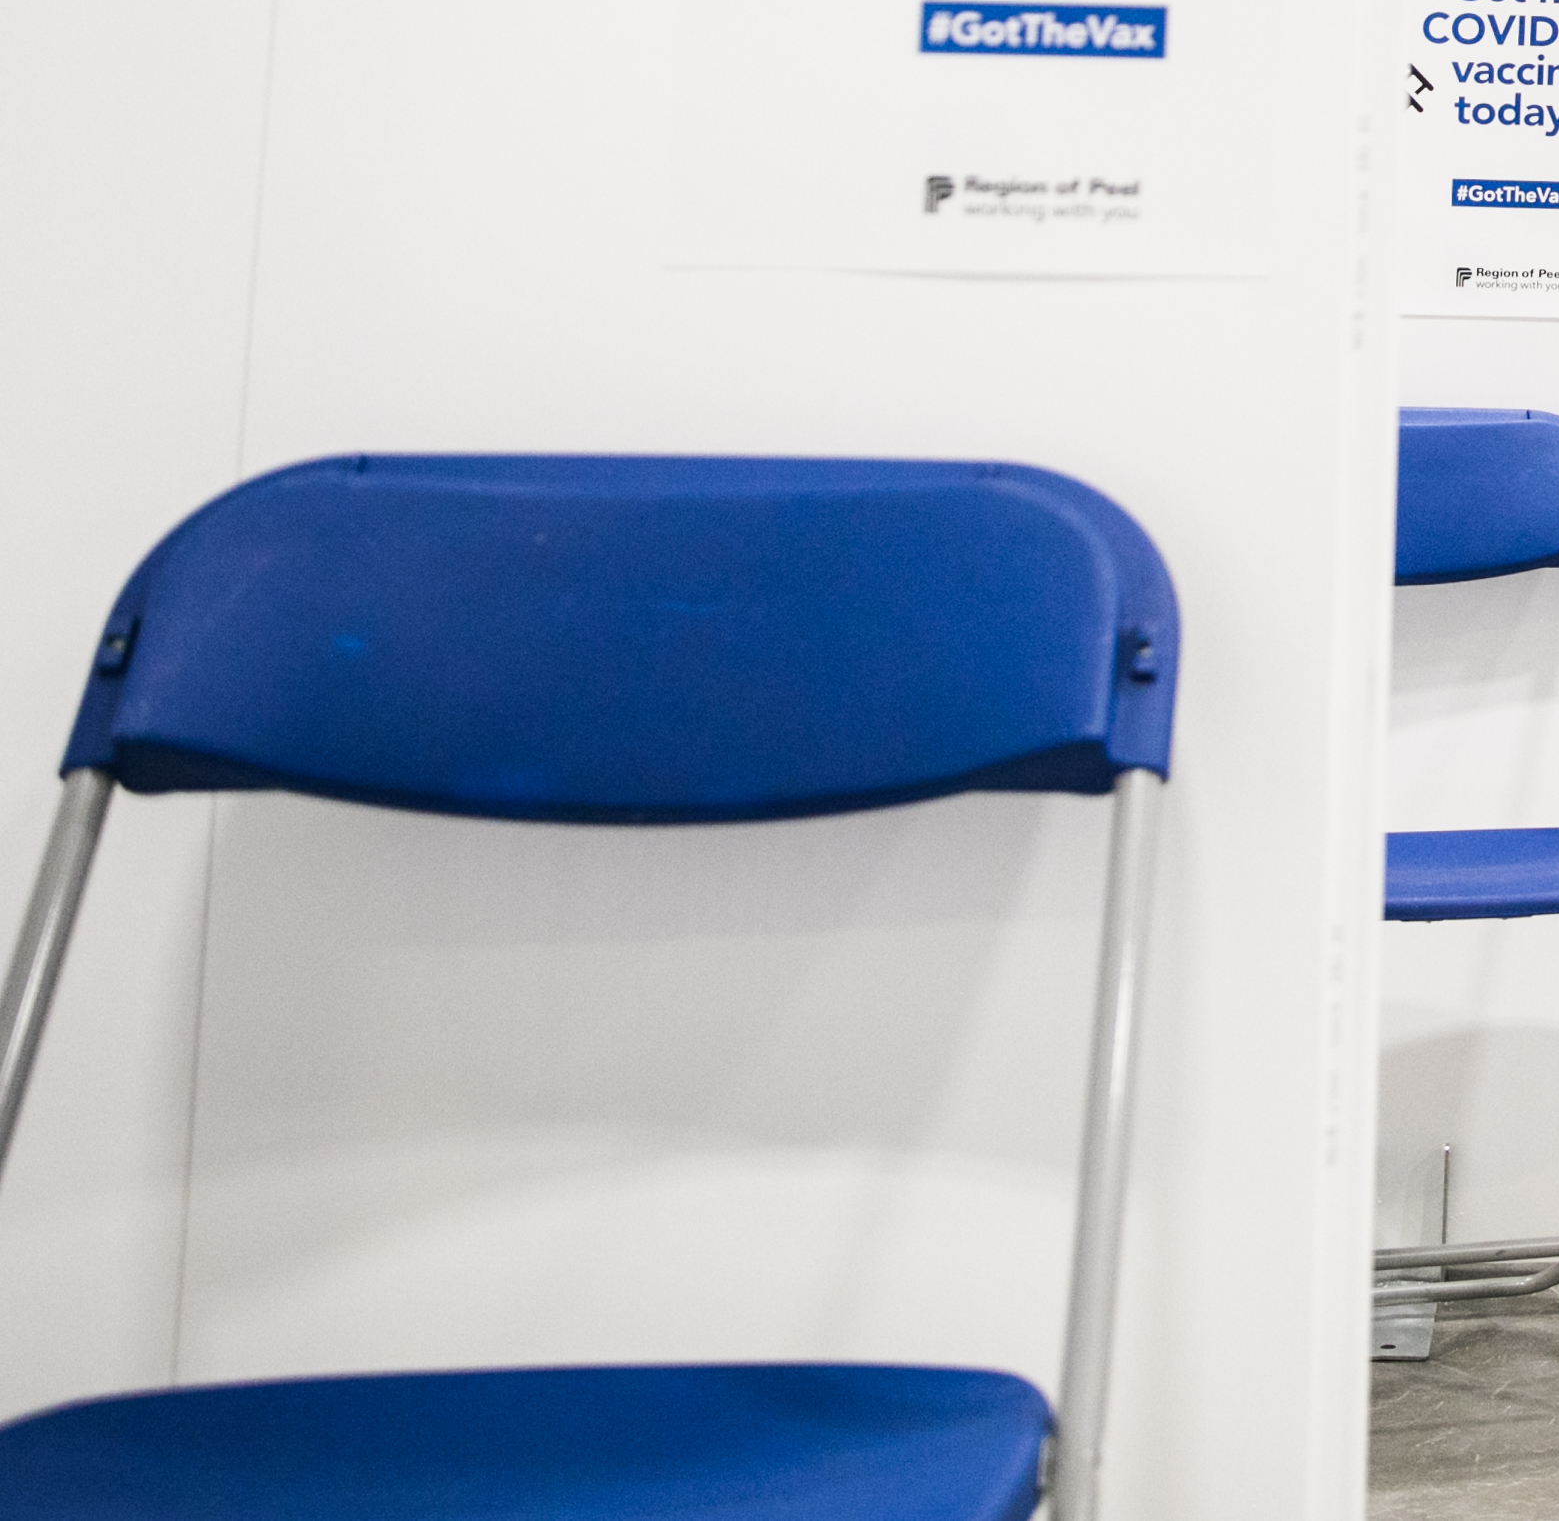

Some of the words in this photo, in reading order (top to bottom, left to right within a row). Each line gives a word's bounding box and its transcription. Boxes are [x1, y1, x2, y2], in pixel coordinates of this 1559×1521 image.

[926, 11, 1157, 50] #GotTheVax
[963, 175, 1048, 199] Region
[1054, 178, 1080, 196] of
[1476, 267, 1519, 280] Region
[1521, 269, 1535, 279] of
[1475, 280, 1518, 292] working
[1520, 280, 1543, 291] with
